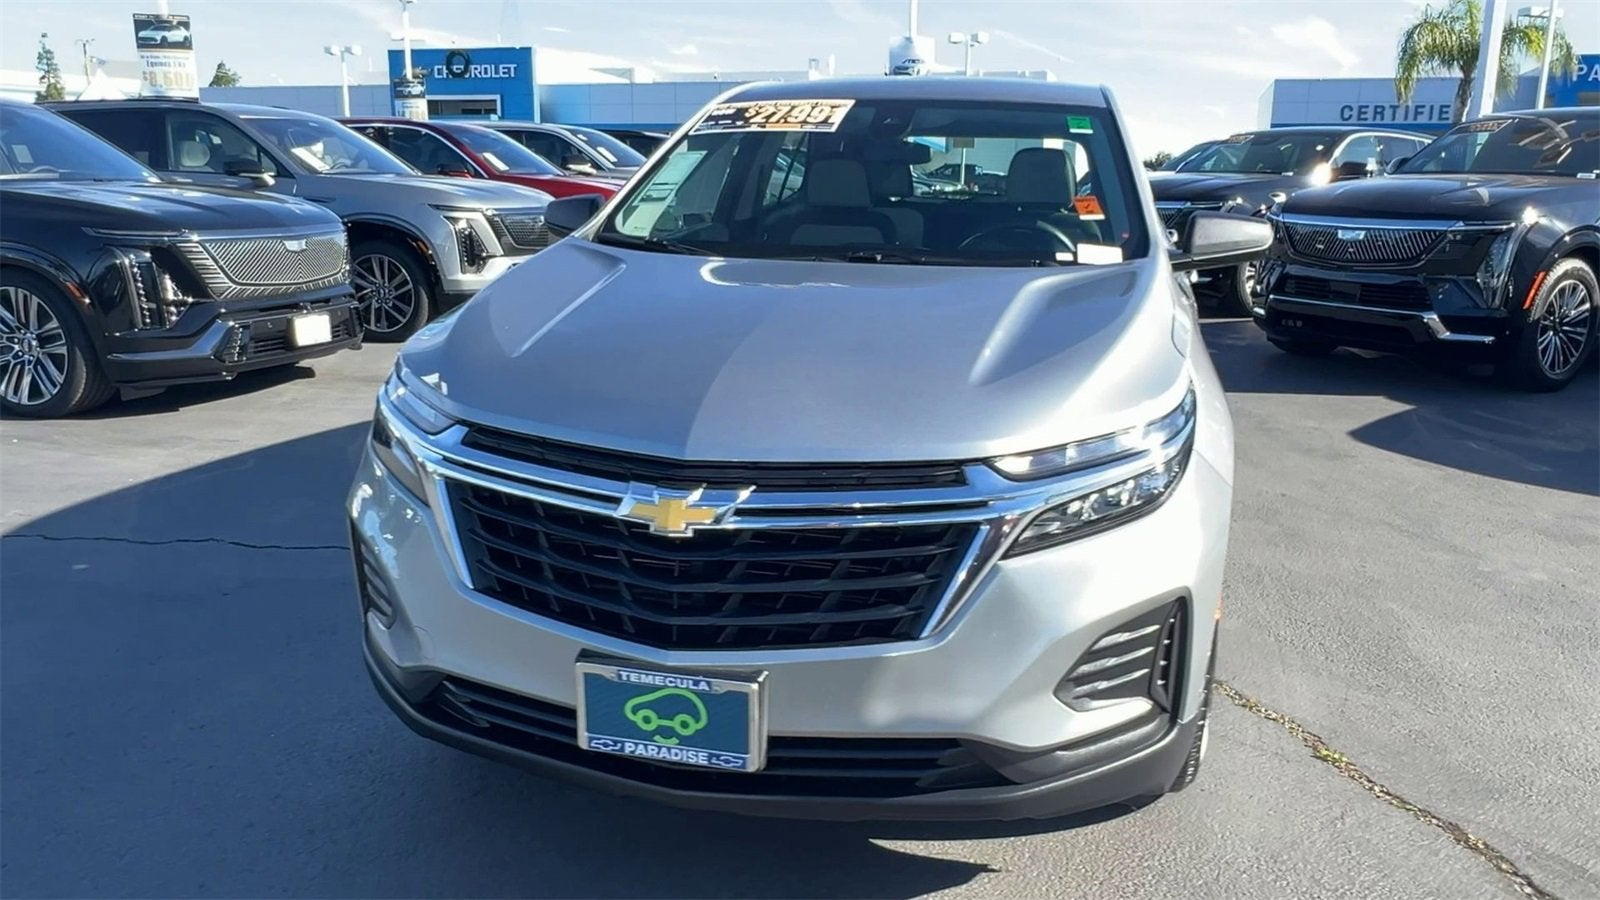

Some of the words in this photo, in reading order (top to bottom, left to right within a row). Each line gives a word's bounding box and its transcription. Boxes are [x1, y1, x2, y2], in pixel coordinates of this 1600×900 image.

[1340, 104, 1453, 121] CERTIFIE
[619, 671, 710, 691] TEMECULA
[624, 742, 709, 764] PARADISE
